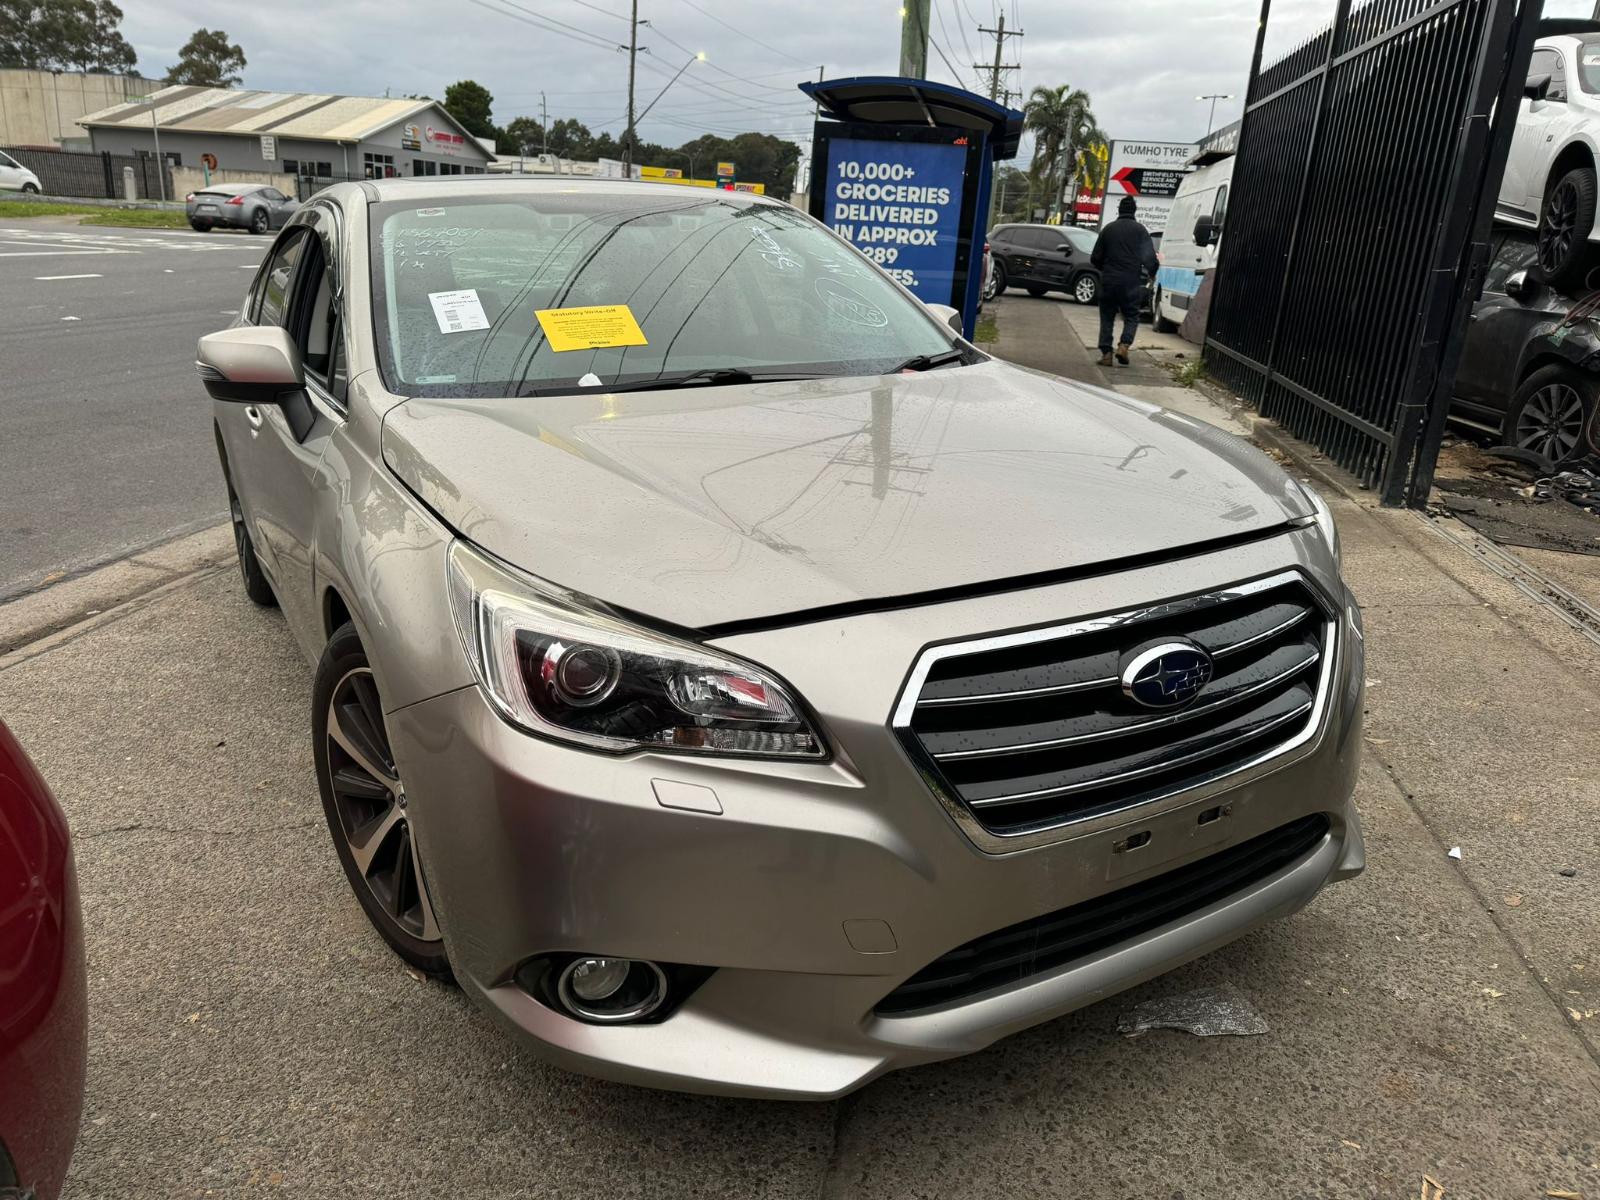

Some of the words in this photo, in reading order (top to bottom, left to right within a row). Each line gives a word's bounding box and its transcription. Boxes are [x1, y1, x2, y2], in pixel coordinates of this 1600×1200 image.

[1123, 145, 1161, 156] KUMHO
[1163, 147, 1189, 157] TYRE
[838, 161, 915, 181] 10,000+
[836, 182, 950, 205] GROCERIES
[835, 203, 939, 225] DELIVERED
[833, 224, 854, 241] IN
[857, 226, 939, 246] APPROX
